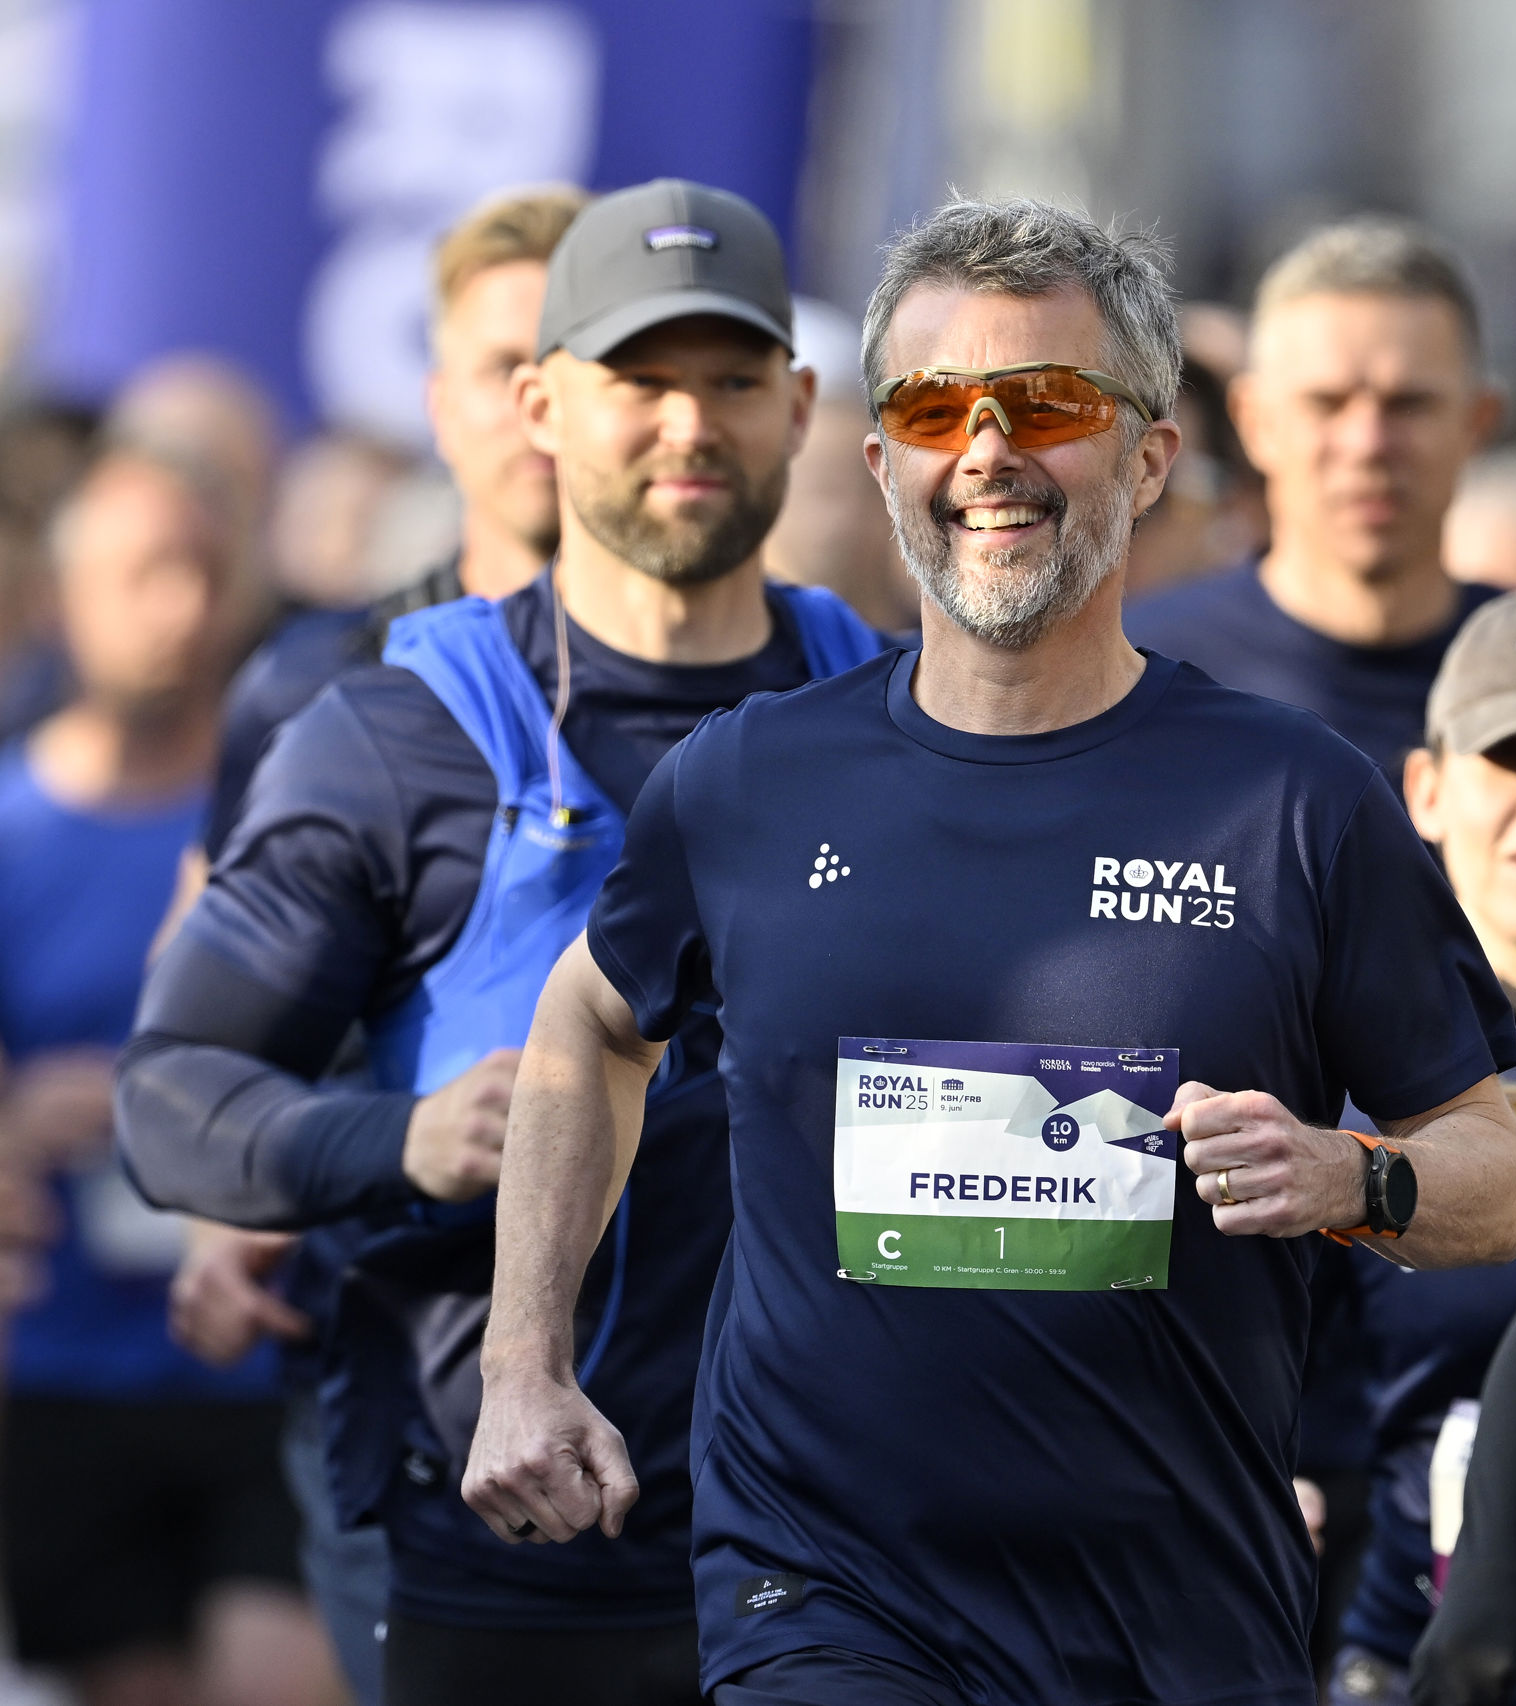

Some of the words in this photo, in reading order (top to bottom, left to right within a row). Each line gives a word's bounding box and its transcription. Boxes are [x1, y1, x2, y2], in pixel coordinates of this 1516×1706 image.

[1093, 856, 1236, 895] ROYAL
[1122, 1065, 1162, 1073] TrygFonden
[859, 1074, 928, 1092] ROYAL
[940, 1095, 982, 1103] KBH/FRB
[1050, 1121, 1072, 1136] 10
[1053, 1137, 1068, 1145] km
[910, 1172, 1097, 1204] FREDERIK
[877, 1230, 902, 1260] C
[994, 1227, 1005, 1260] 1
[871, 1262, 908, 1271] Startgruppe
[957, 1266, 995, 1274] Startgruppe
